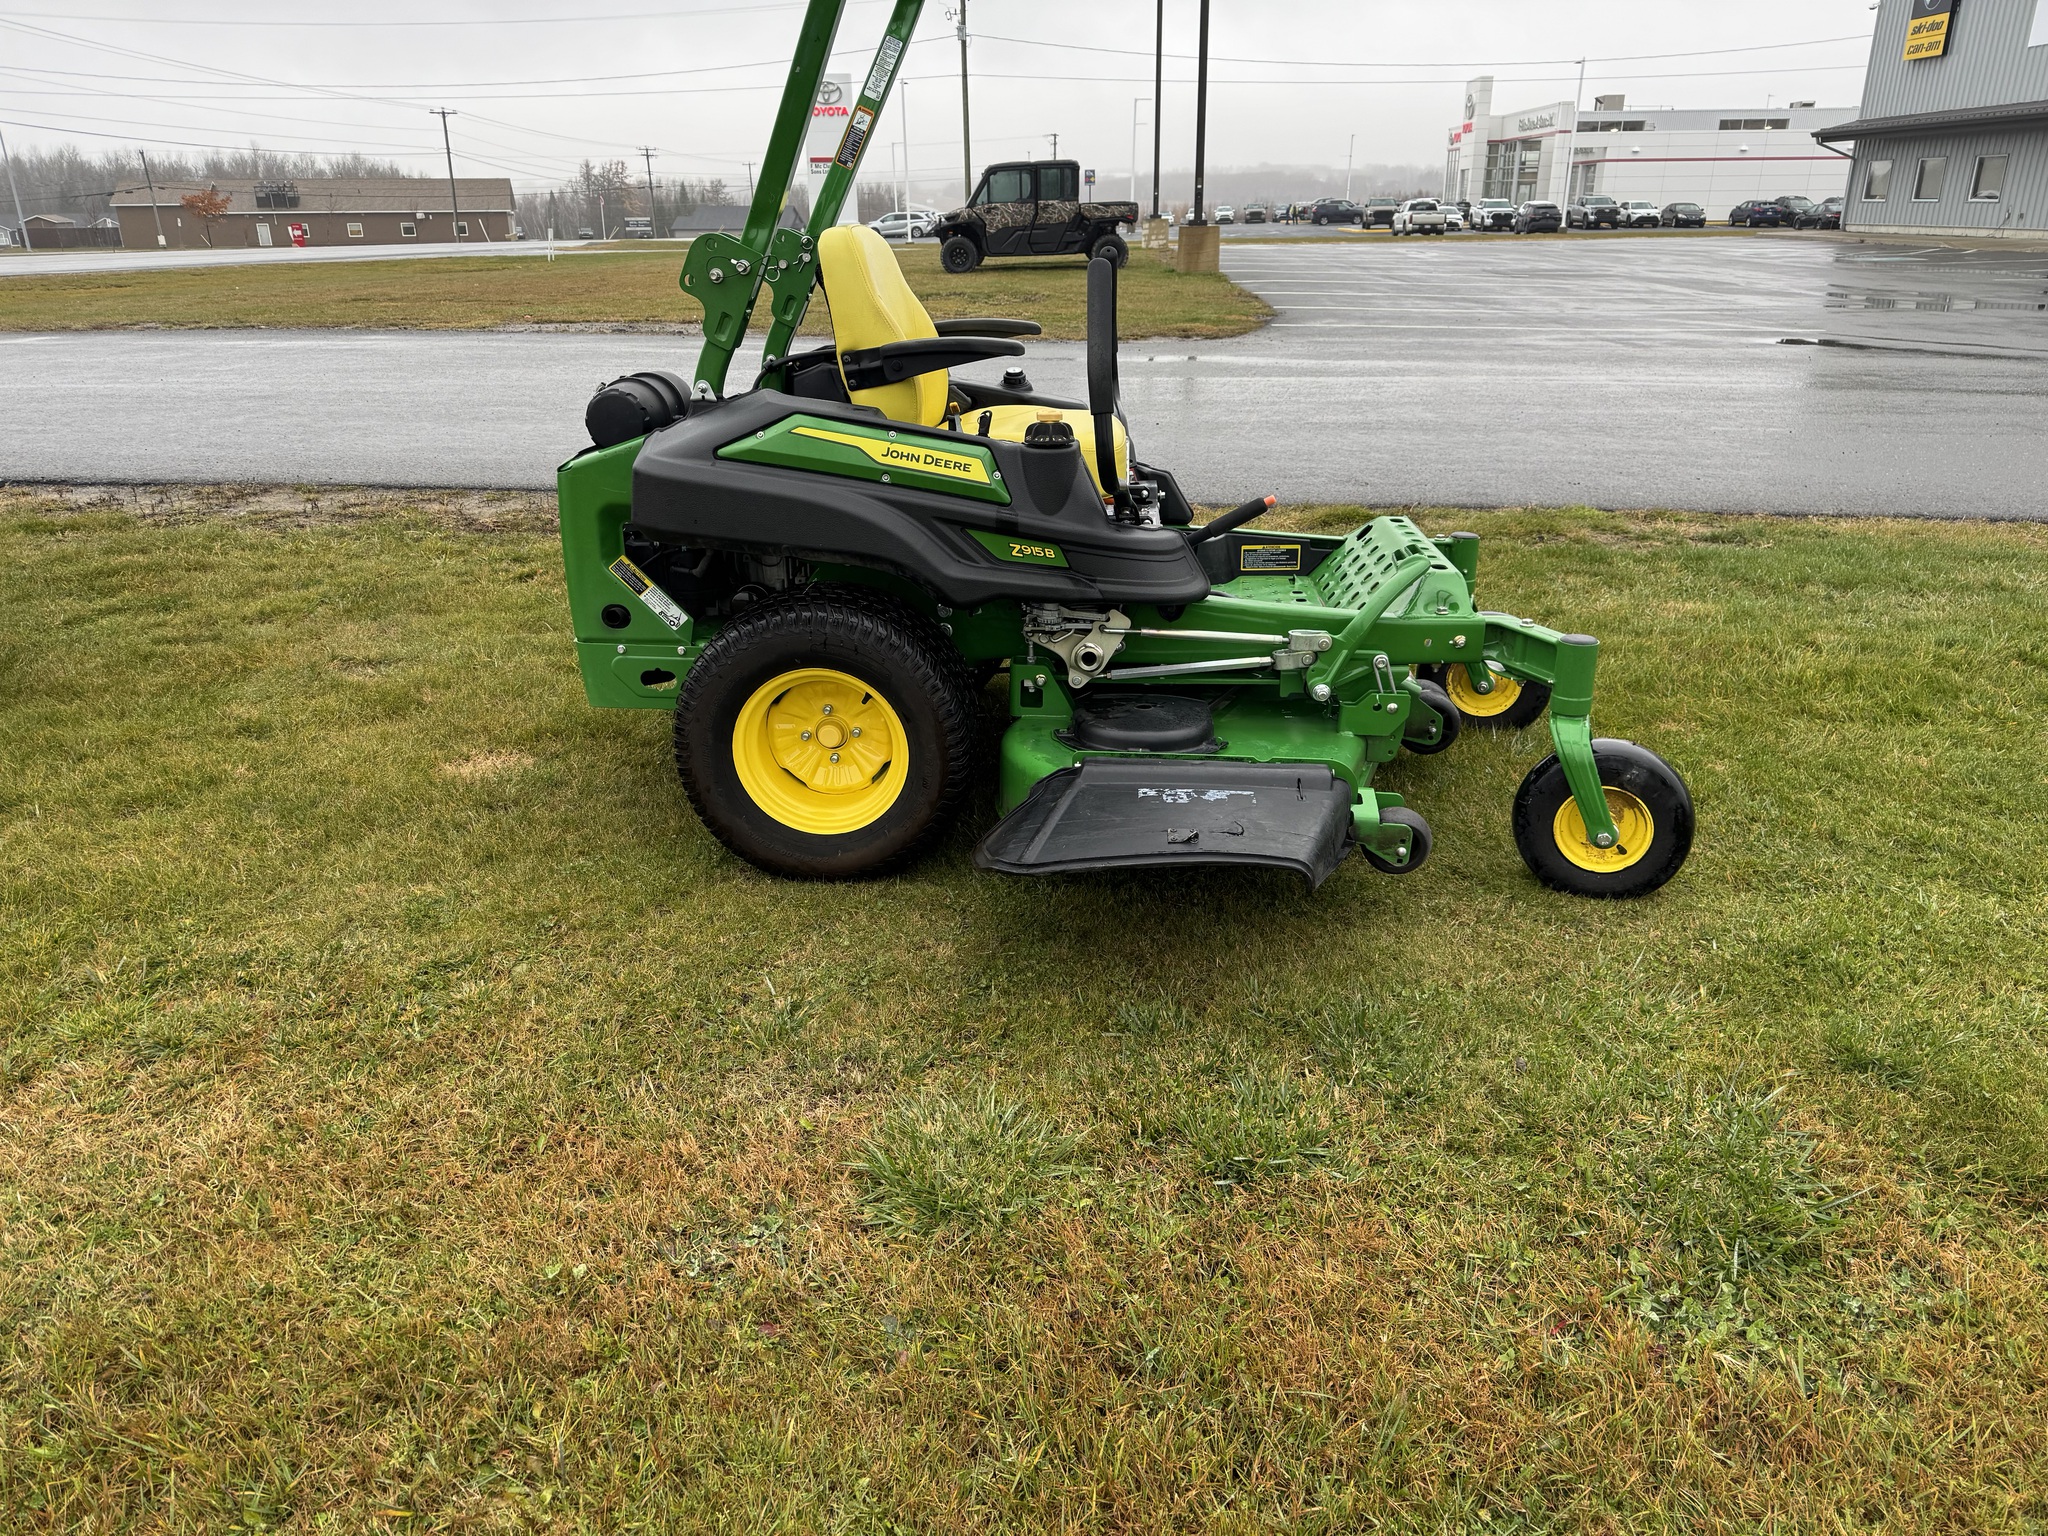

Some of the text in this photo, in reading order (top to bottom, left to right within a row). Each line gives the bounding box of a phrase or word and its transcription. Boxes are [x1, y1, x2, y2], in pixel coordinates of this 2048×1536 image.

[1911, 20, 1944, 35] ski-doo
[1906, 40, 1941, 55] can-am
[813, 106, 849, 117] OYOTA
[881, 447, 972, 472] JOHN DEERE
